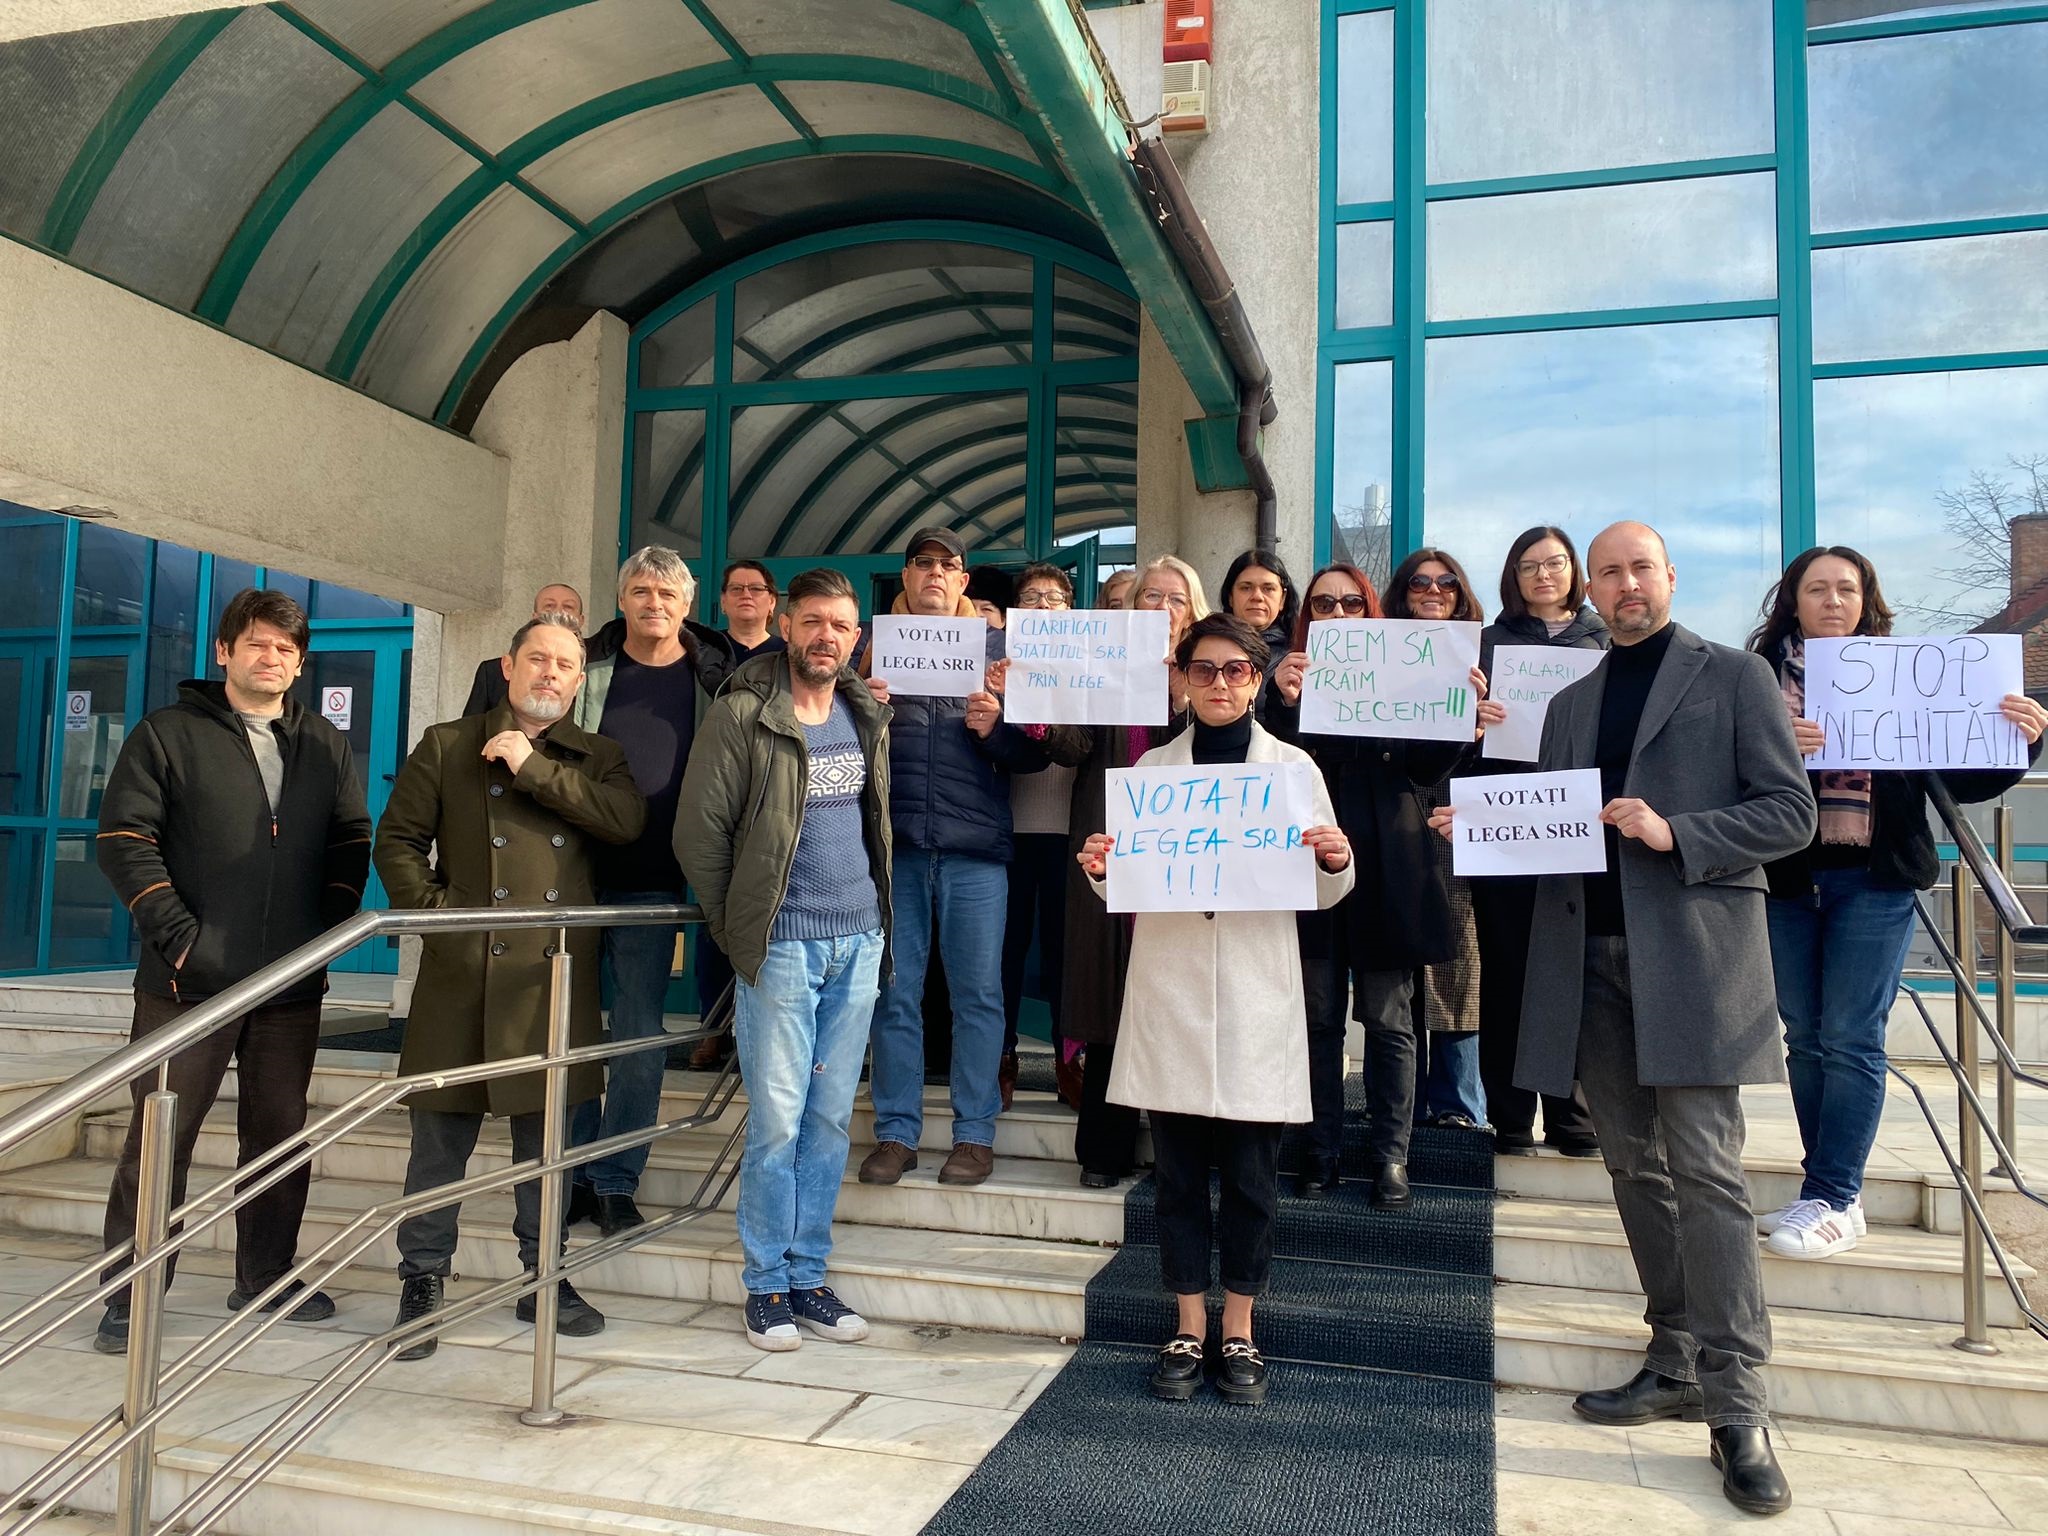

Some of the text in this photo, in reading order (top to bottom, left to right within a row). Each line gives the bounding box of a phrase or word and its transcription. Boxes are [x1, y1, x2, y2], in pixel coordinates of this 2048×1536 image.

[898, 628, 961, 645] VOTAȚI
[1012, 643, 1128, 659] STATUTUL SRR
[1311, 628, 1386, 665] VREM
[882, 656, 974, 671] LEGEA SRR
[1503, 658, 1577, 680] SALARII
[1832, 636, 1989, 697] STOP
[1028, 671, 1105, 688] PRIN LEGE
[1496, 685, 1555, 703] CONDIT
[1483, 788, 1567, 806] VOTAȚI
[1115, 824, 1304, 858] LEGEA SRR
[1467, 822, 1590, 843] LEGEA SRR
